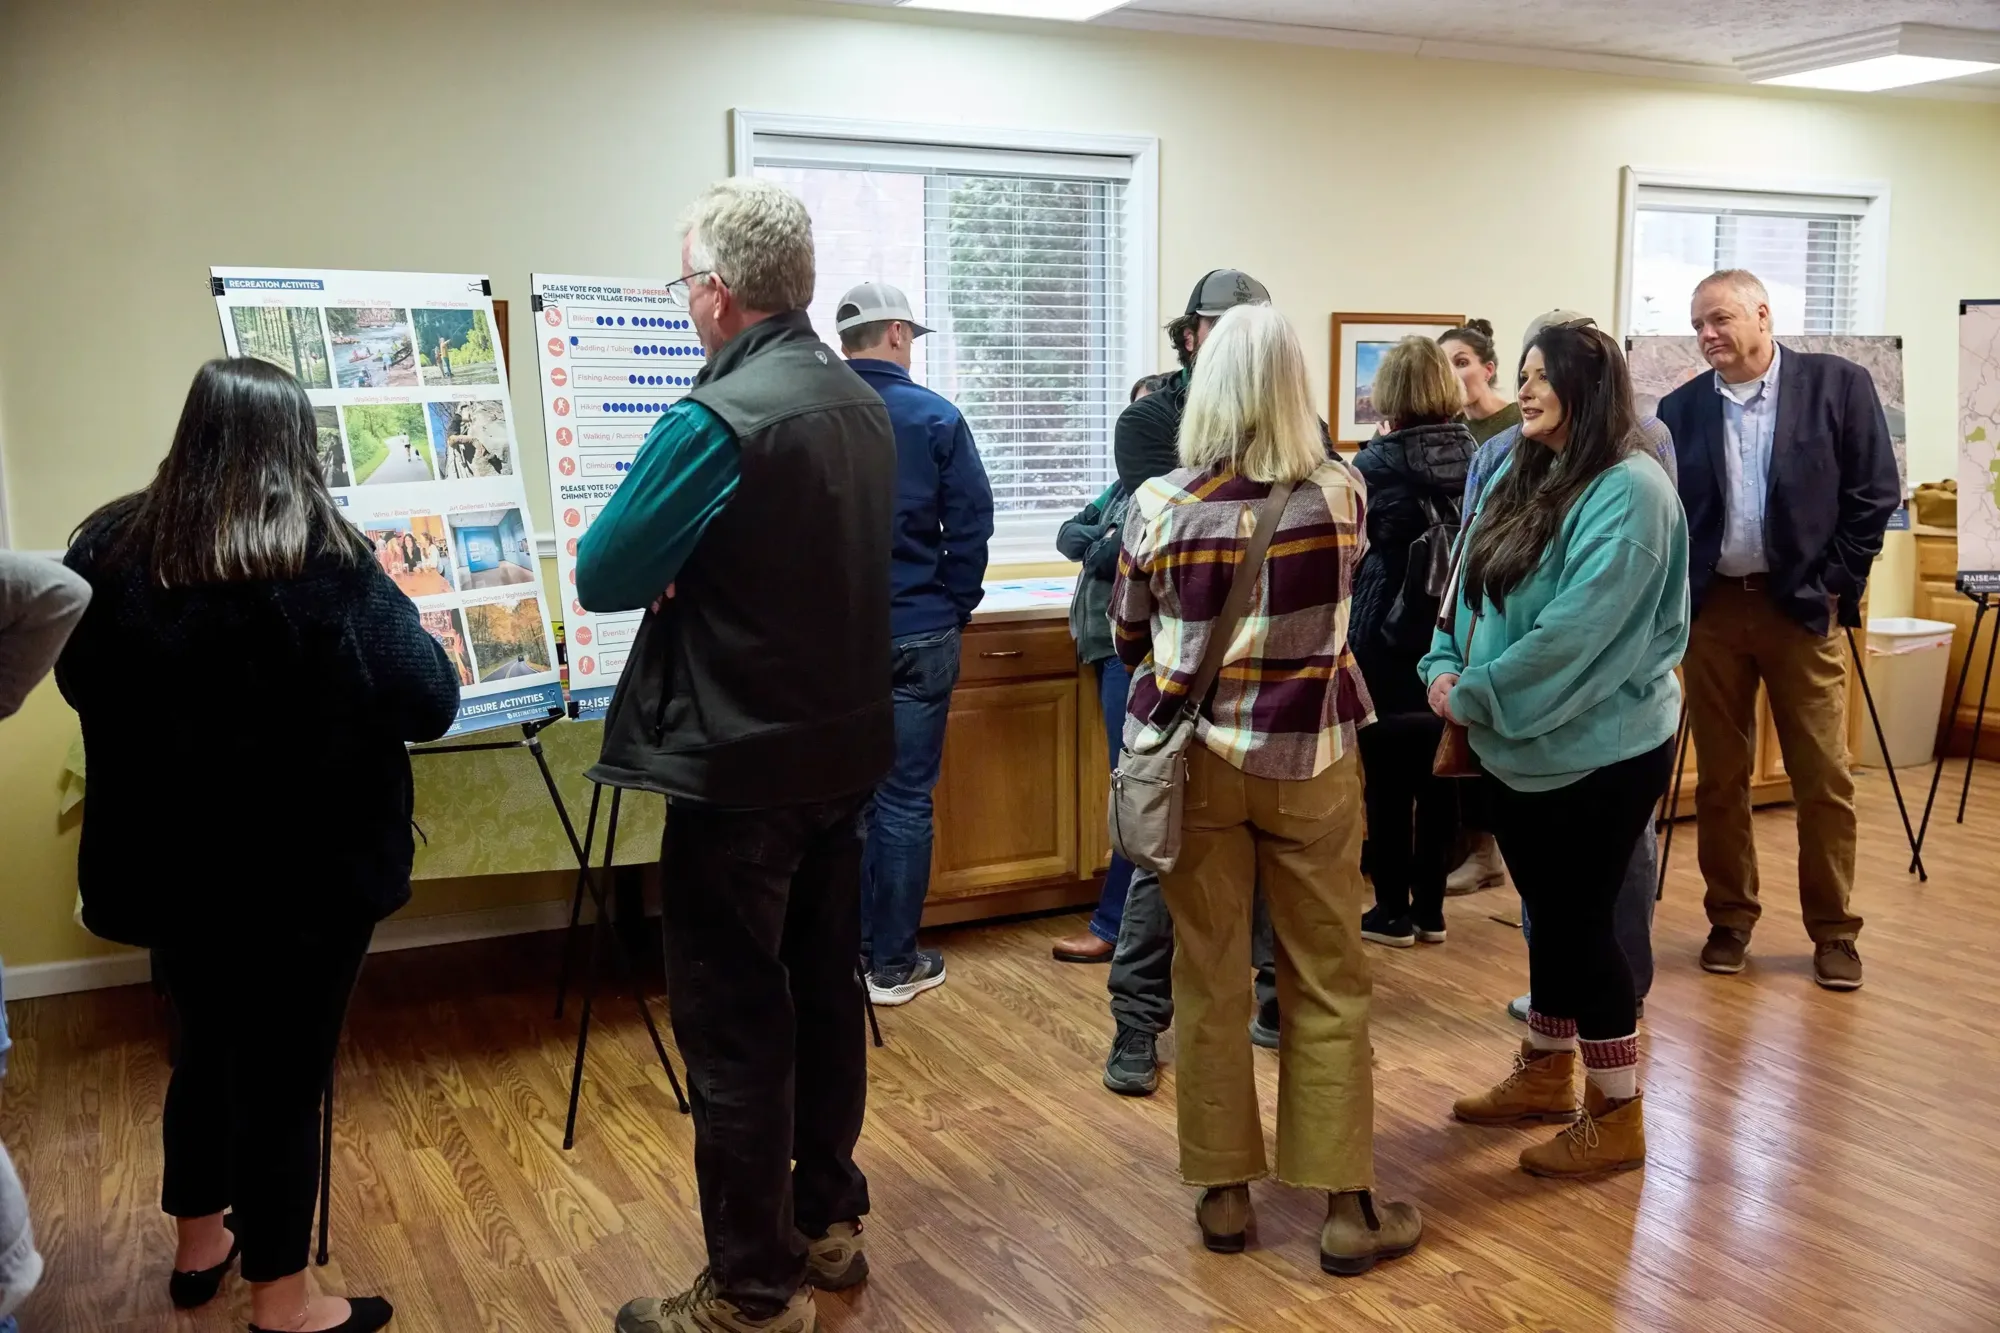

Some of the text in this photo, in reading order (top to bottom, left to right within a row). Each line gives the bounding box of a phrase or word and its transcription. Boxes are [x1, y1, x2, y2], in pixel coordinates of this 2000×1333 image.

[229, 280, 321, 289] RECREATION ACTIVITES
[542, 284, 568, 292] PLEASE
[543, 292, 575, 300] CHIMNEY
[573, 315, 594, 323] Biking
[576, 345, 605, 353] Paddling
[611, 345, 633, 353] Tubing
[578, 374, 603, 382] Fishing
[616, 432, 643, 440] Running
[586, 462, 616, 470] Climbing
[1964, 574, 1988, 582] RAISE
[462, 701, 498, 716] LEISURE
[499, 693, 544, 709] ACTIVITIES
[579, 696, 610, 709] RAISE
